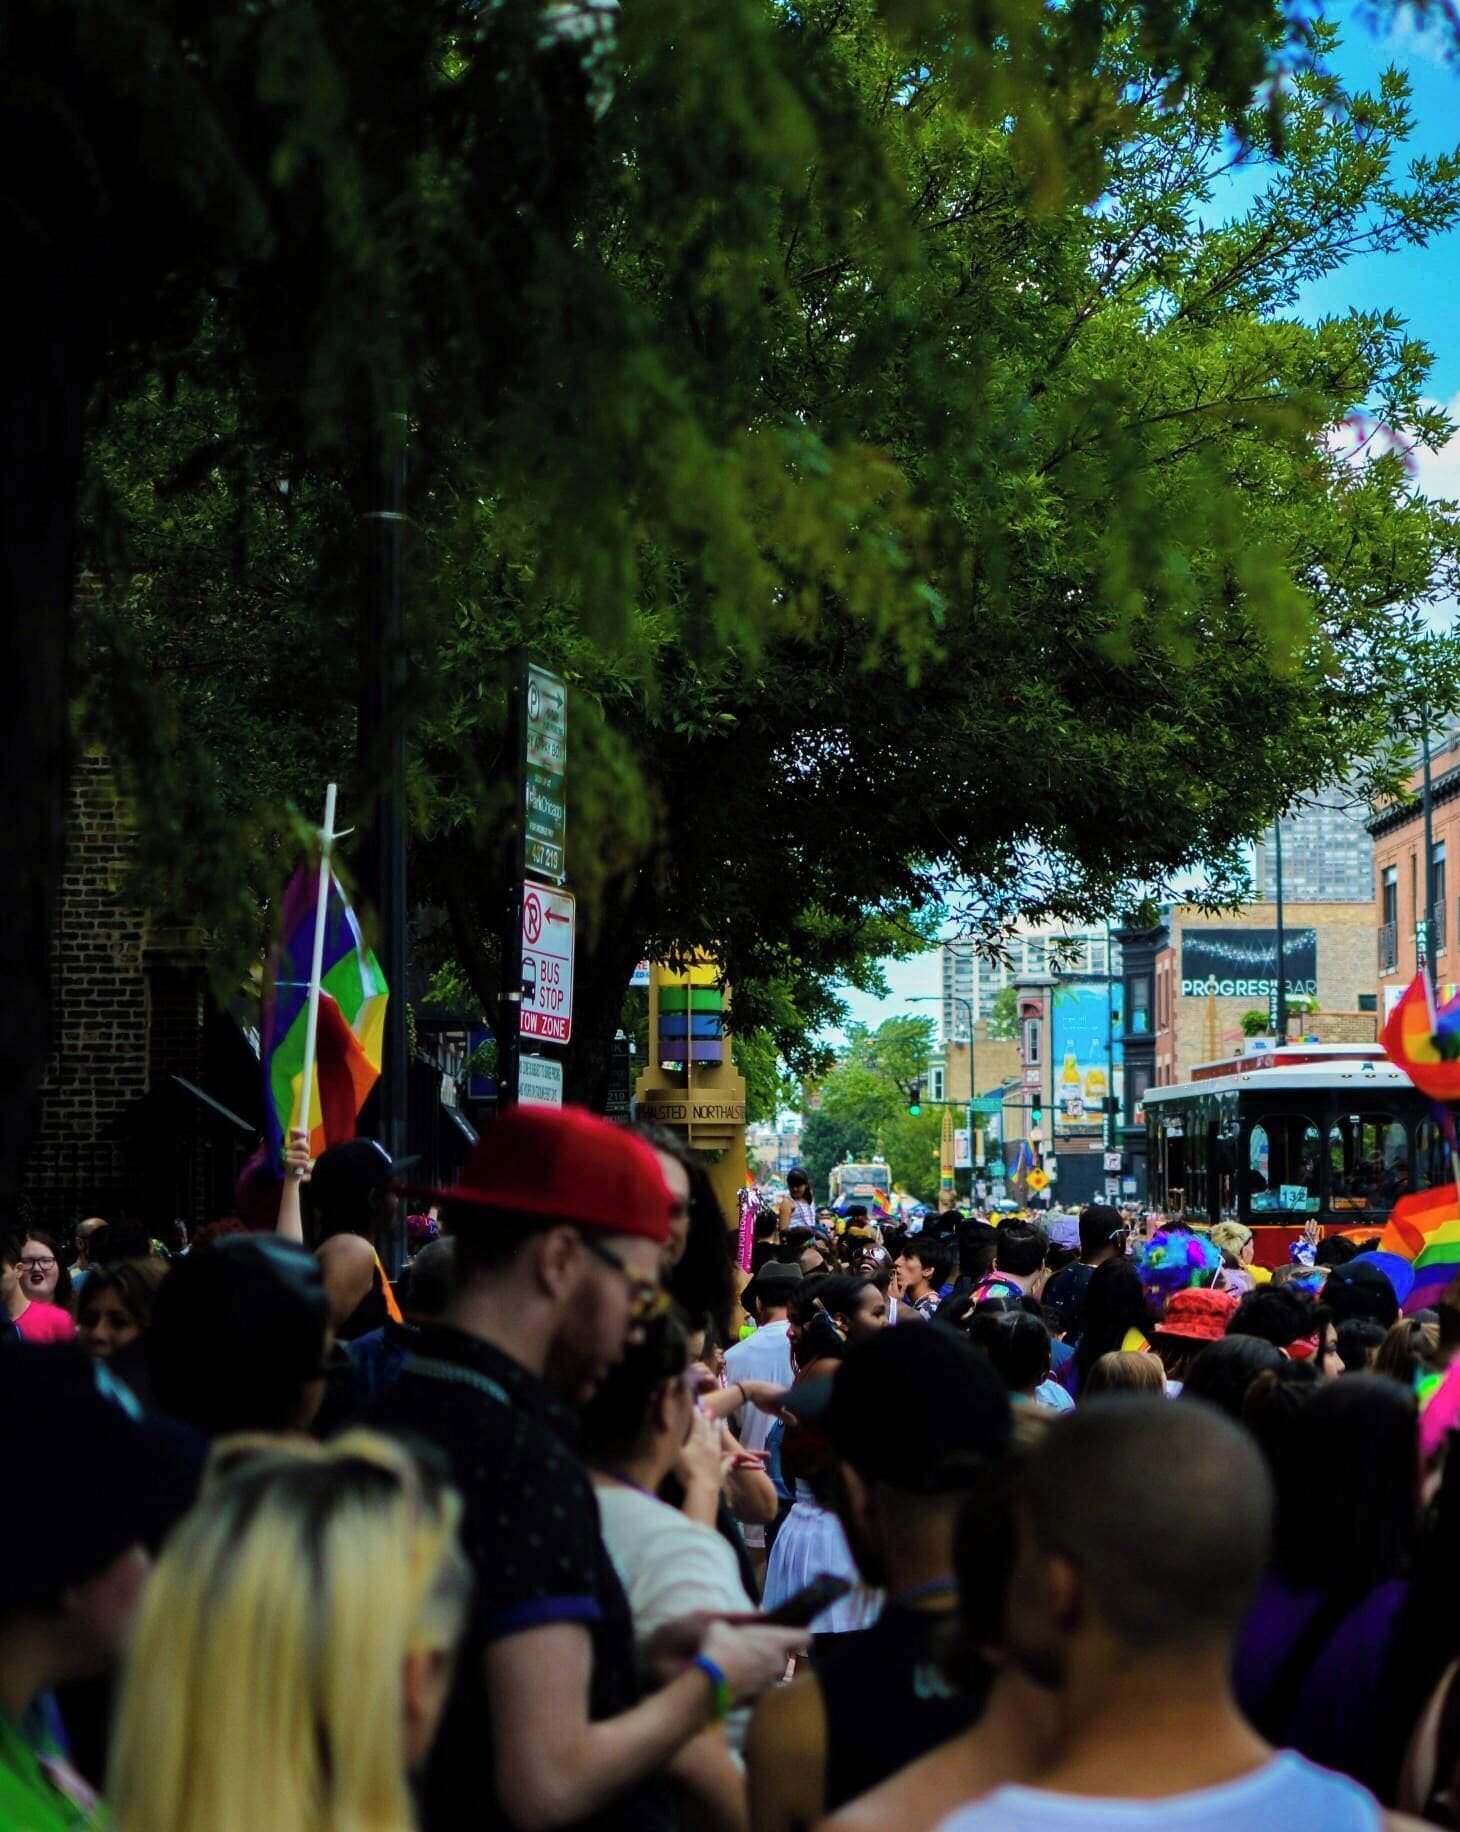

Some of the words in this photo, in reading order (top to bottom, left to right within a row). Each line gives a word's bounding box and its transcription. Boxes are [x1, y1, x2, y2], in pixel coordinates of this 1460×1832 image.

[541, 960, 559, 985] BUS
[1182, 979, 1270, 996] PROGRES
[539, 987, 564, 1011] STOP
[541, 1018, 565, 1037] ZONE
